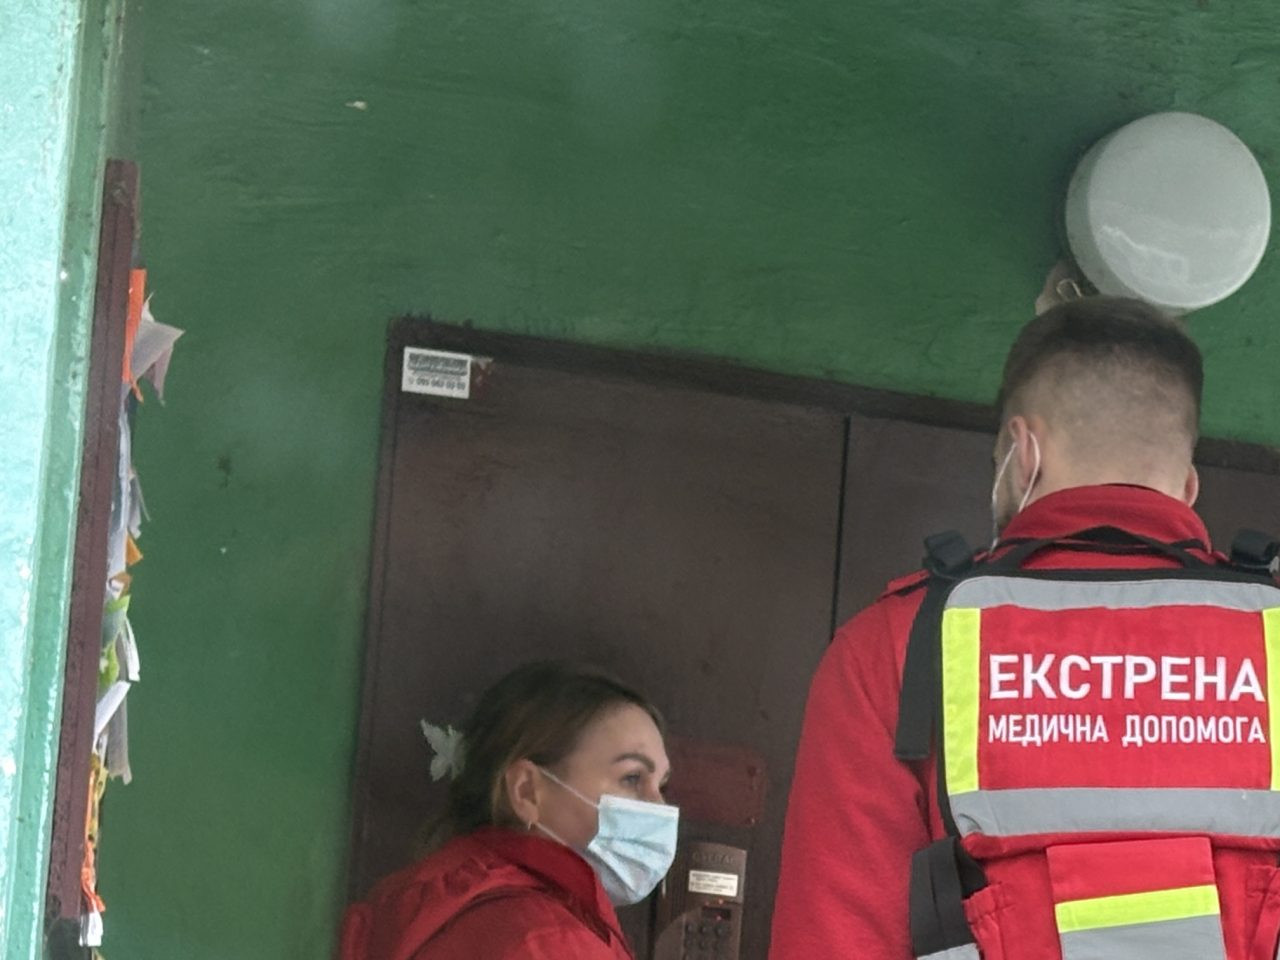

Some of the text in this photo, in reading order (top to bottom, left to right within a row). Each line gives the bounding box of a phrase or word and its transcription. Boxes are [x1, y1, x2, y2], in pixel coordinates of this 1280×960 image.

[989, 653, 1266, 702] ЕКСТРЕНА
[988, 714, 1267, 747] МЕДИЧНА ДОПОМОГА
